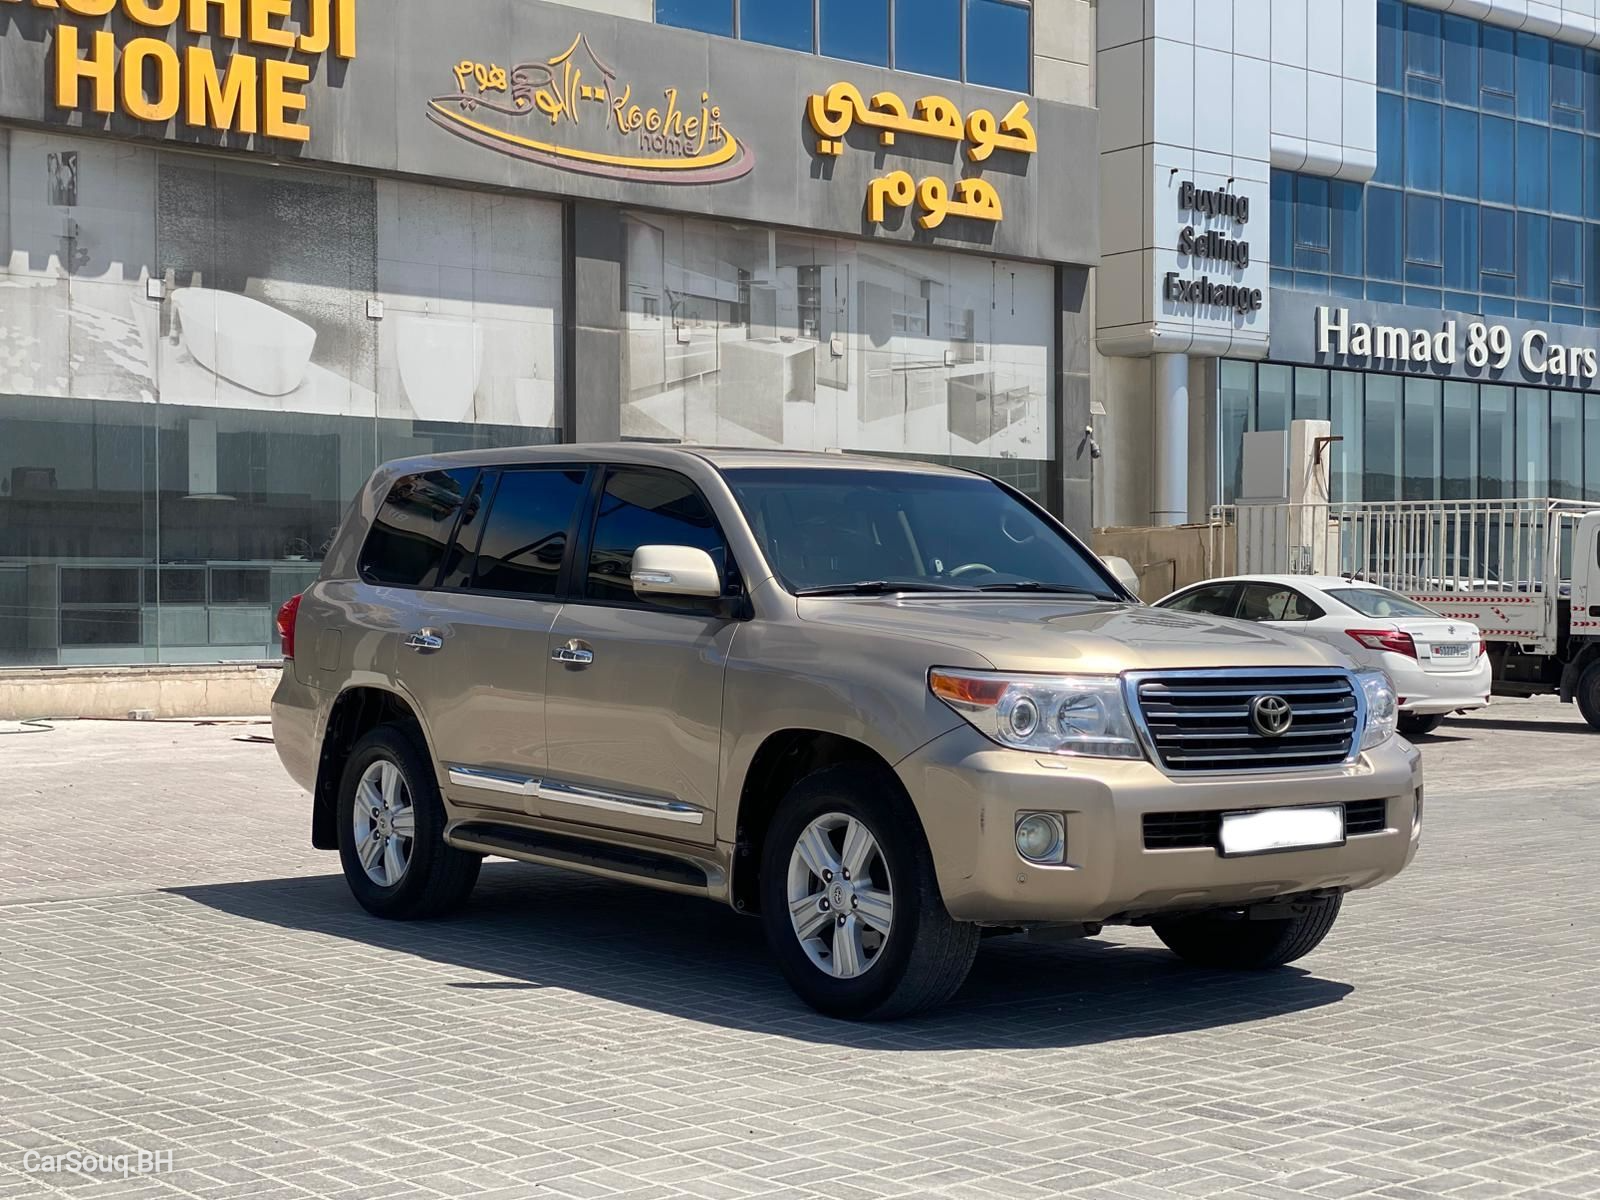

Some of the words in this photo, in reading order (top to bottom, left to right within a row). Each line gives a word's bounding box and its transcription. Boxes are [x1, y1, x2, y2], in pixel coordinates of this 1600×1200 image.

[56, 24, 310, 142] HOME
[604, 78, 721, 156] Kooheji
[639, 127, 700, 157] home
[807, 81, 1038, 162] كوهجي
[867, 170, 1004, 229] هوم
[1180, 181, 1250, 225] Buying
[1179, 226, 1250, 270] Selling
[1165, 271, 1263, 316] Exchange
[1315, 305, 1457, 365] Hamad
[1465, 322, 1513, 370] 89
[1520, 329, 1598, 379] Cars
